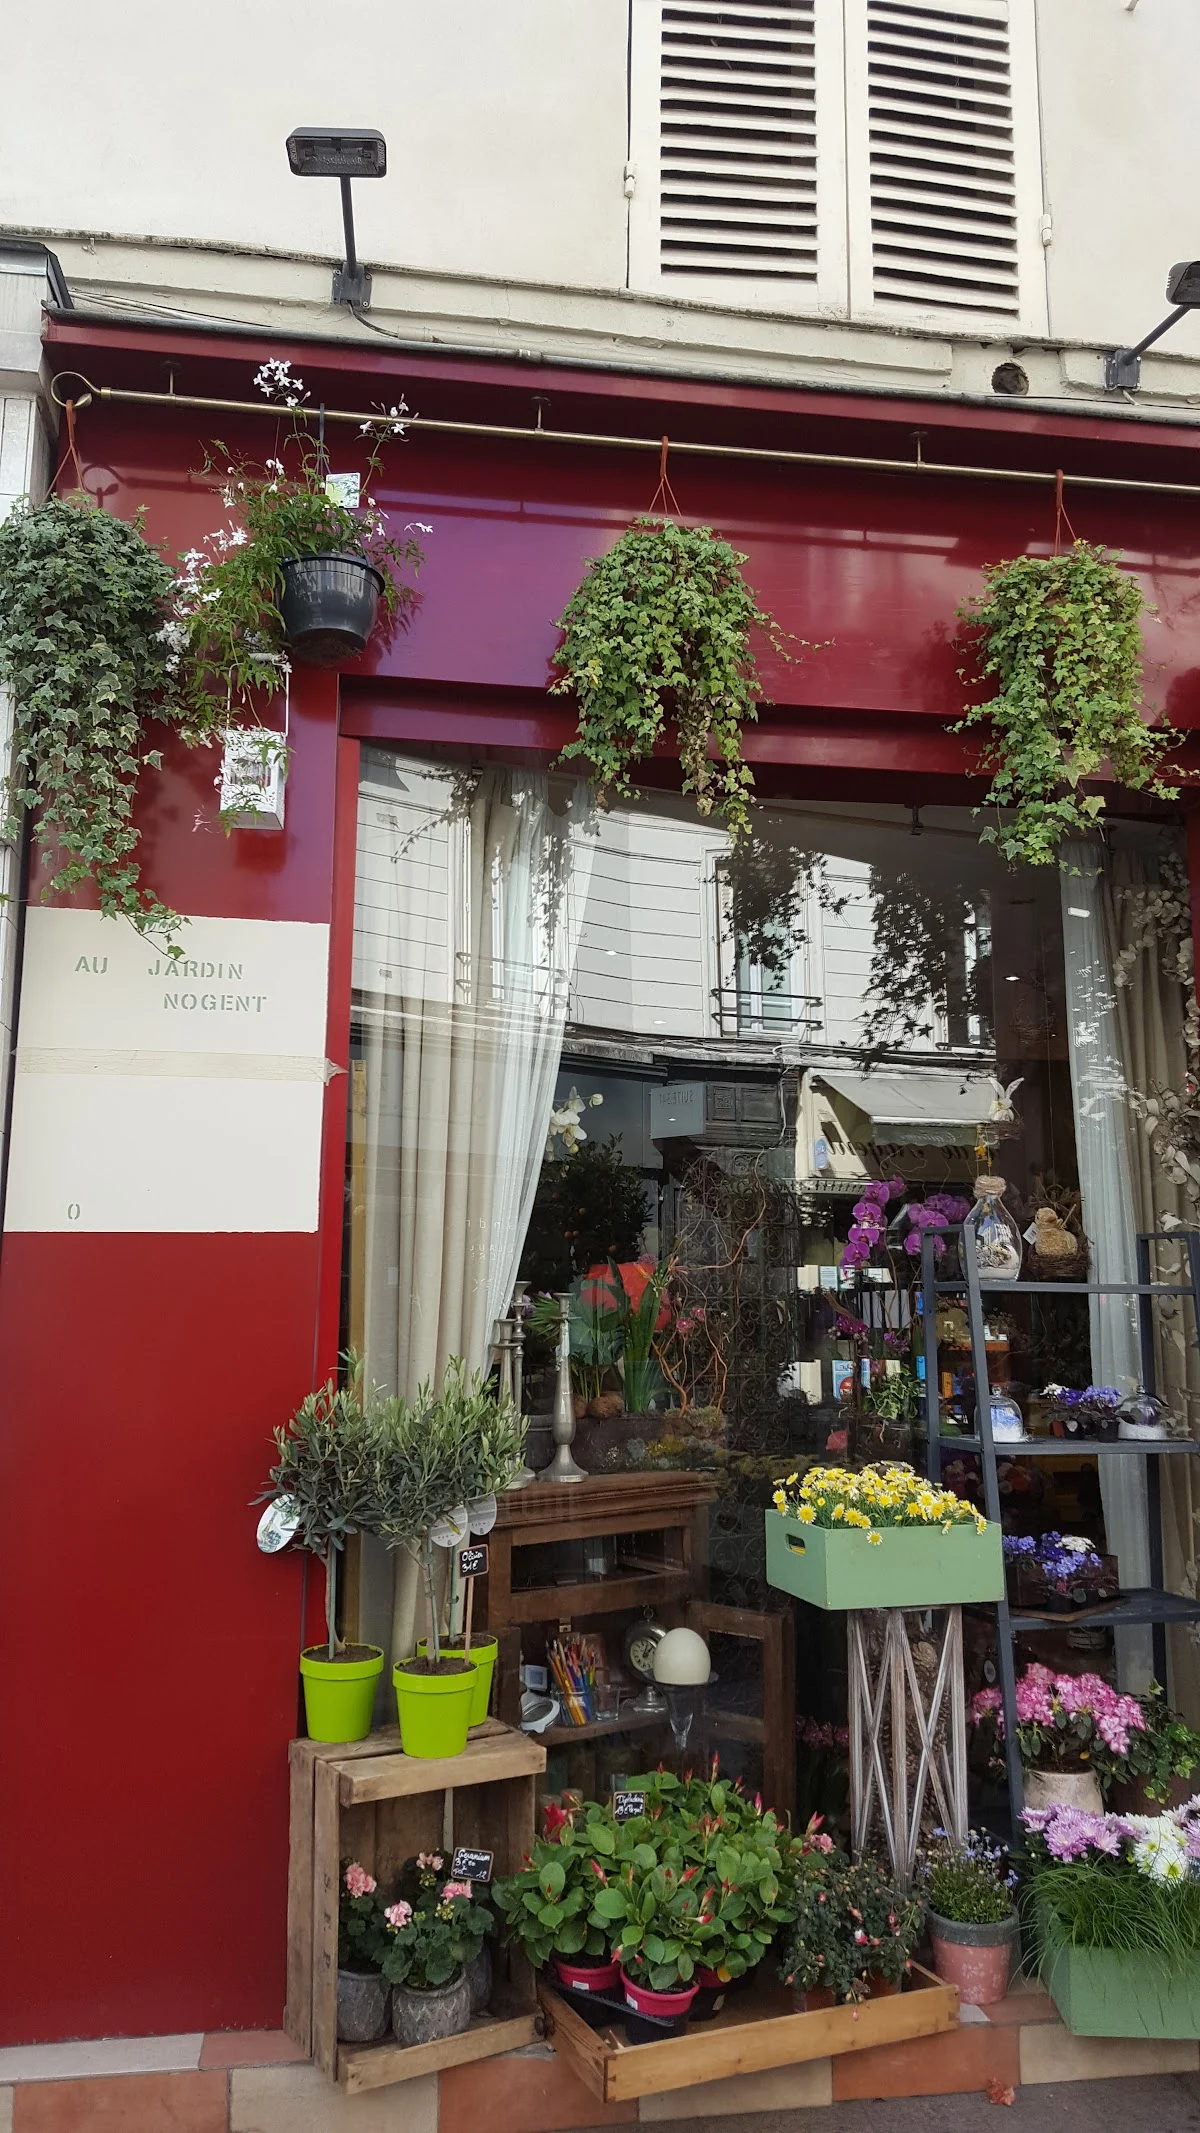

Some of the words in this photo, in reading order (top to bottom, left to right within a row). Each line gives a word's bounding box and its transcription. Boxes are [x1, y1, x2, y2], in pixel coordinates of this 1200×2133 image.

[75, 955, 109, 975] AU
[147, 958, 243, 980] JARDIN
[163, 993, 267, 1013] NOGENT
